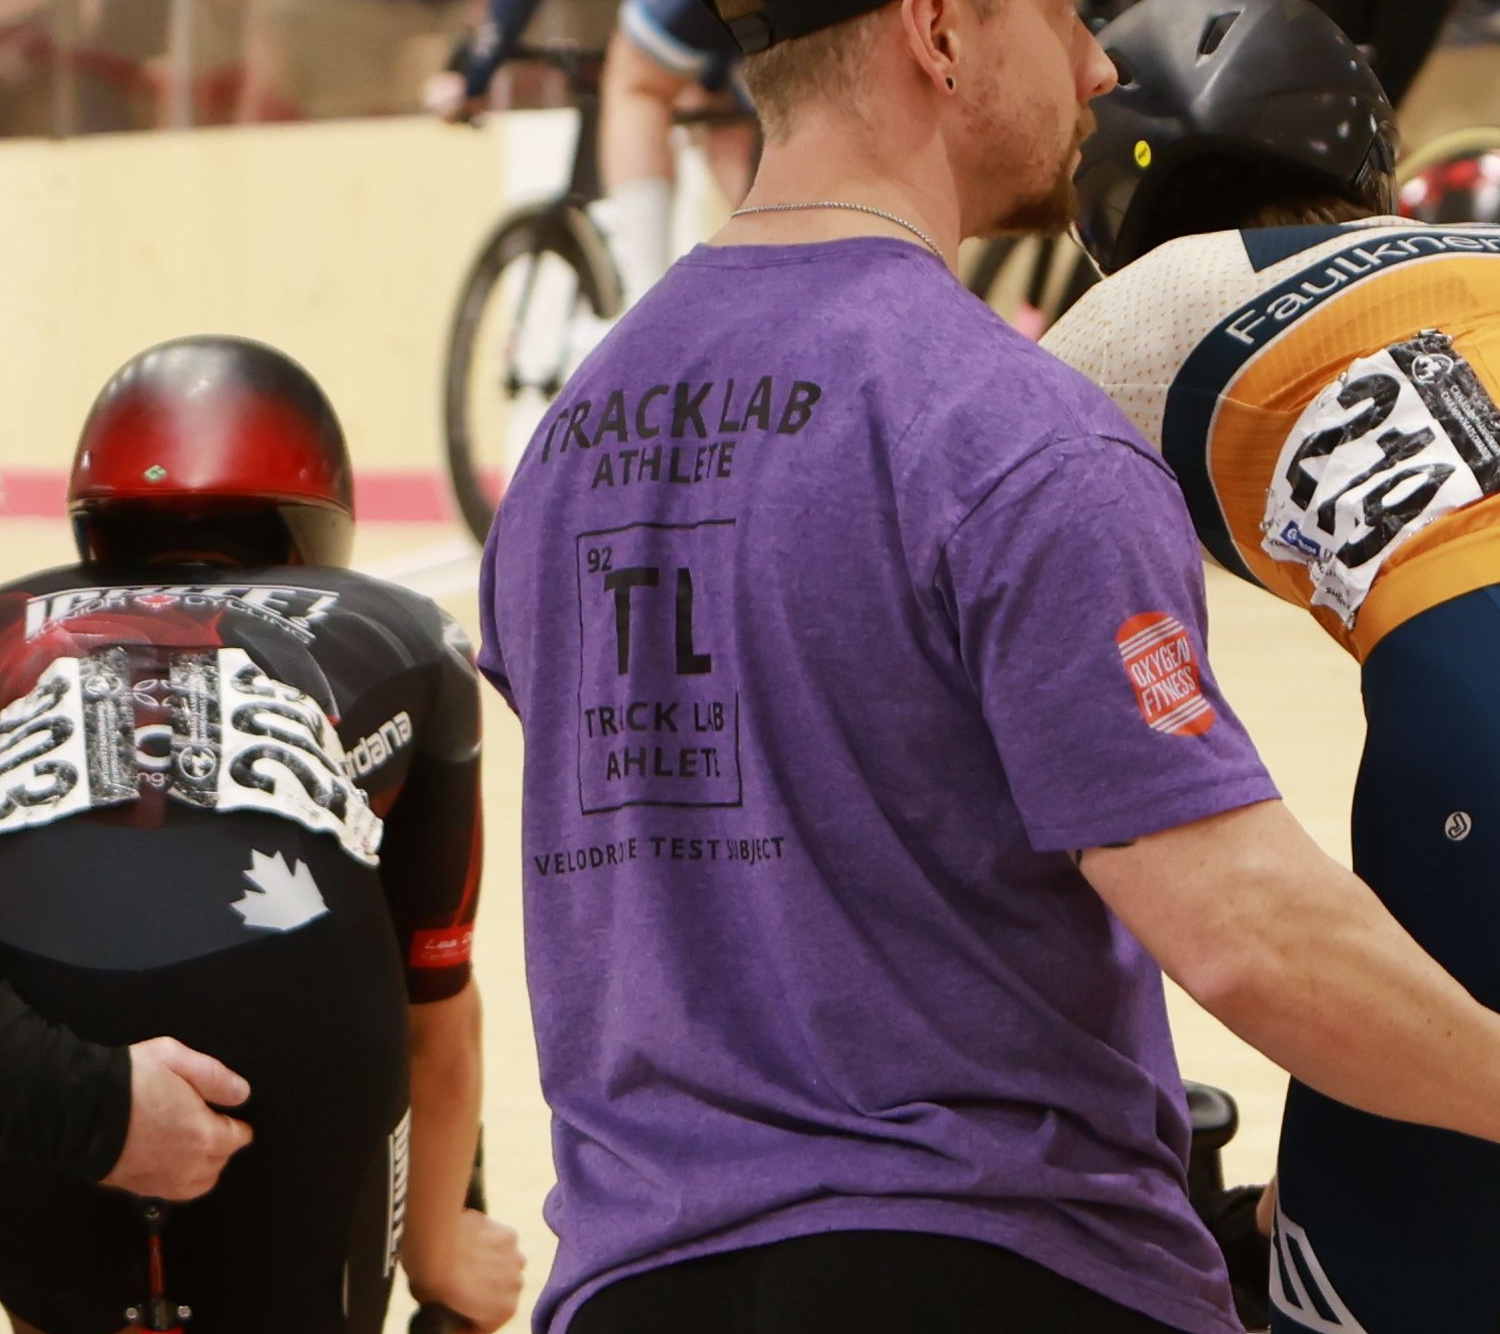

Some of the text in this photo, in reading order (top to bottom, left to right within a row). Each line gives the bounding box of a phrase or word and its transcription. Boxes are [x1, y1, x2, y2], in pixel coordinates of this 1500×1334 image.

[541, 374, 823, 464] TRACK LAB
[591, 440, 736, 489] ATHLETE
[587, 546, 613, 573] 92
[604, 567, 712, 676] TL
[1131, 636, 1192, 688] OXYGEN
[1142, 665, 1196, 717] FITNESS
[584, 702, 679, 739] TRCK
[606, 747, 721, 781] AHLET
[534, 836, 785, 876] VELODRE TEST SBJECT
